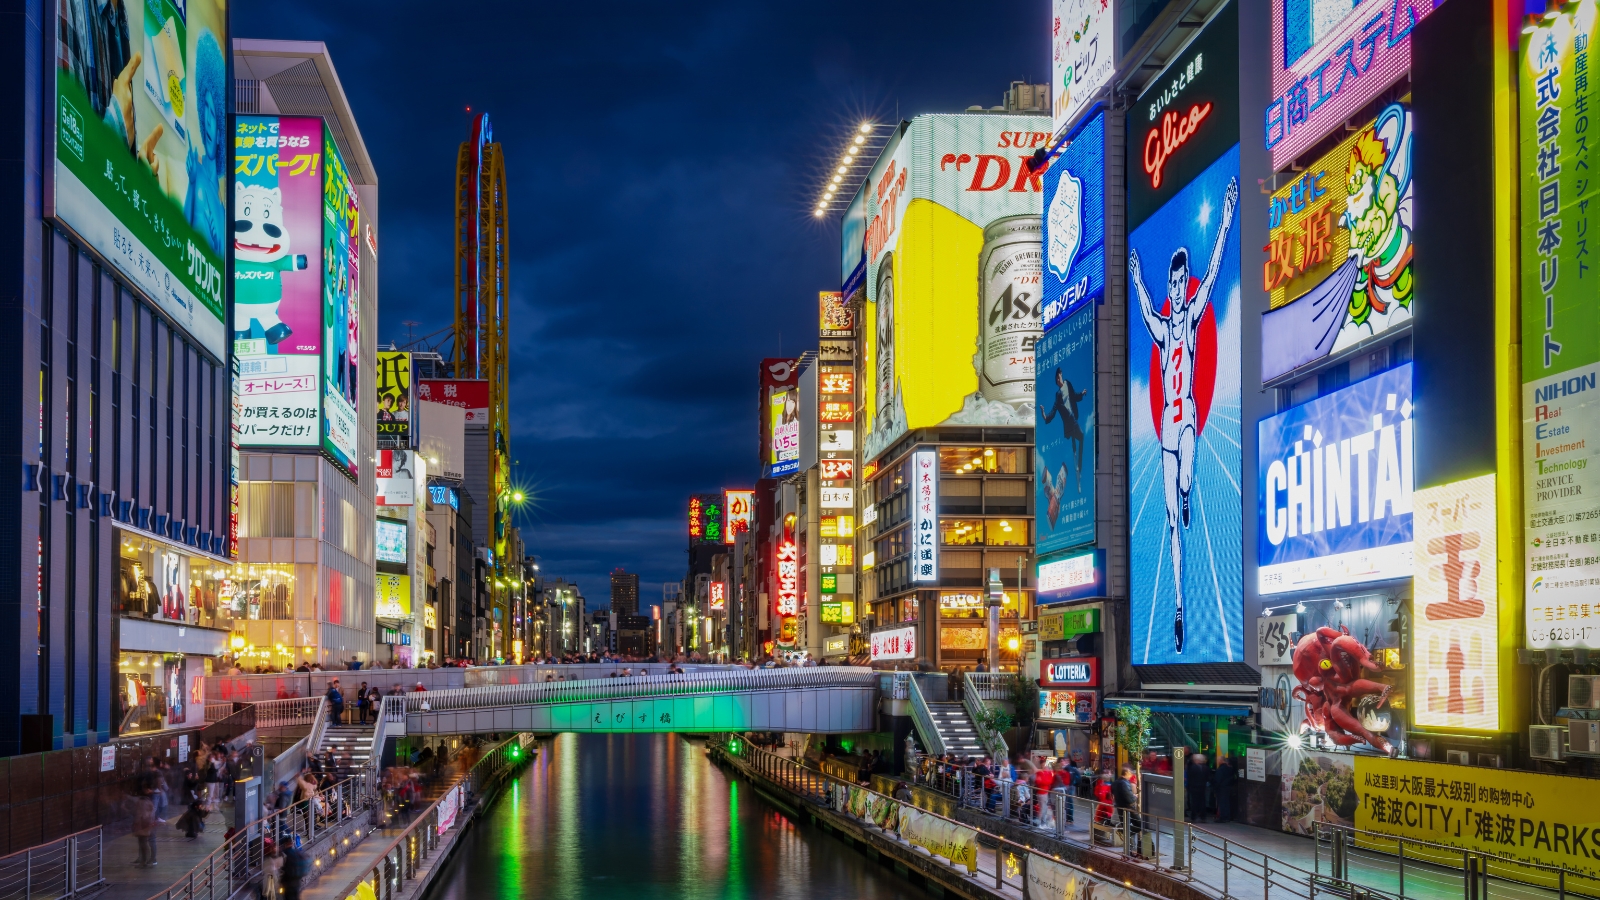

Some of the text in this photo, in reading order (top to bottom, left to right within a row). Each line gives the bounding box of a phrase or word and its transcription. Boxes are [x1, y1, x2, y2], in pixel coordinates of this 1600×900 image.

[1075, 33, 1098, 84] ピップ
[1265, 3, 1416, 150] 日商エステム
[1149, 53, 1203, 121] おいしさと健康
[237, 123, 279, 134] ネットで
[1145, 102, 1213, 189] Glico
[1268, 170, 1326, 229] かぜに
[1536, 31, 1562, 367] 株式会社日本リート
[1263, 202, 1333, 292] 改源
[187, 238, 222, 309] サロンパス
[244, 378, 308, 393] オートレース!
[1172, 340, 1184, 424] グリコ
[1535, 372, 1596, 404] NIHON
[239, 406, 317, 419] が買えるのは
[1535, 404, 1562, 422] Real
[1536, 423, 1570, 440] Estate
[1536, 439, 1585, 458] Investment
[1266, 394, 1413, 546] CHINTAI
[1535, 458, 1588, 475] Technology
[1536, 474, 1574, 489] SERVICE
[1536, 486, 1582, 501] PROVIDER
[920, 472, 933, 575] 本場の味 かに道楽
[776, 543, 797, 615] 大阪王将
[1265, 621, 1289, 657] くくる
[1055, 664, 1087, 680] LOTTERIA
[594, 712, 671, 724] えびす橋
